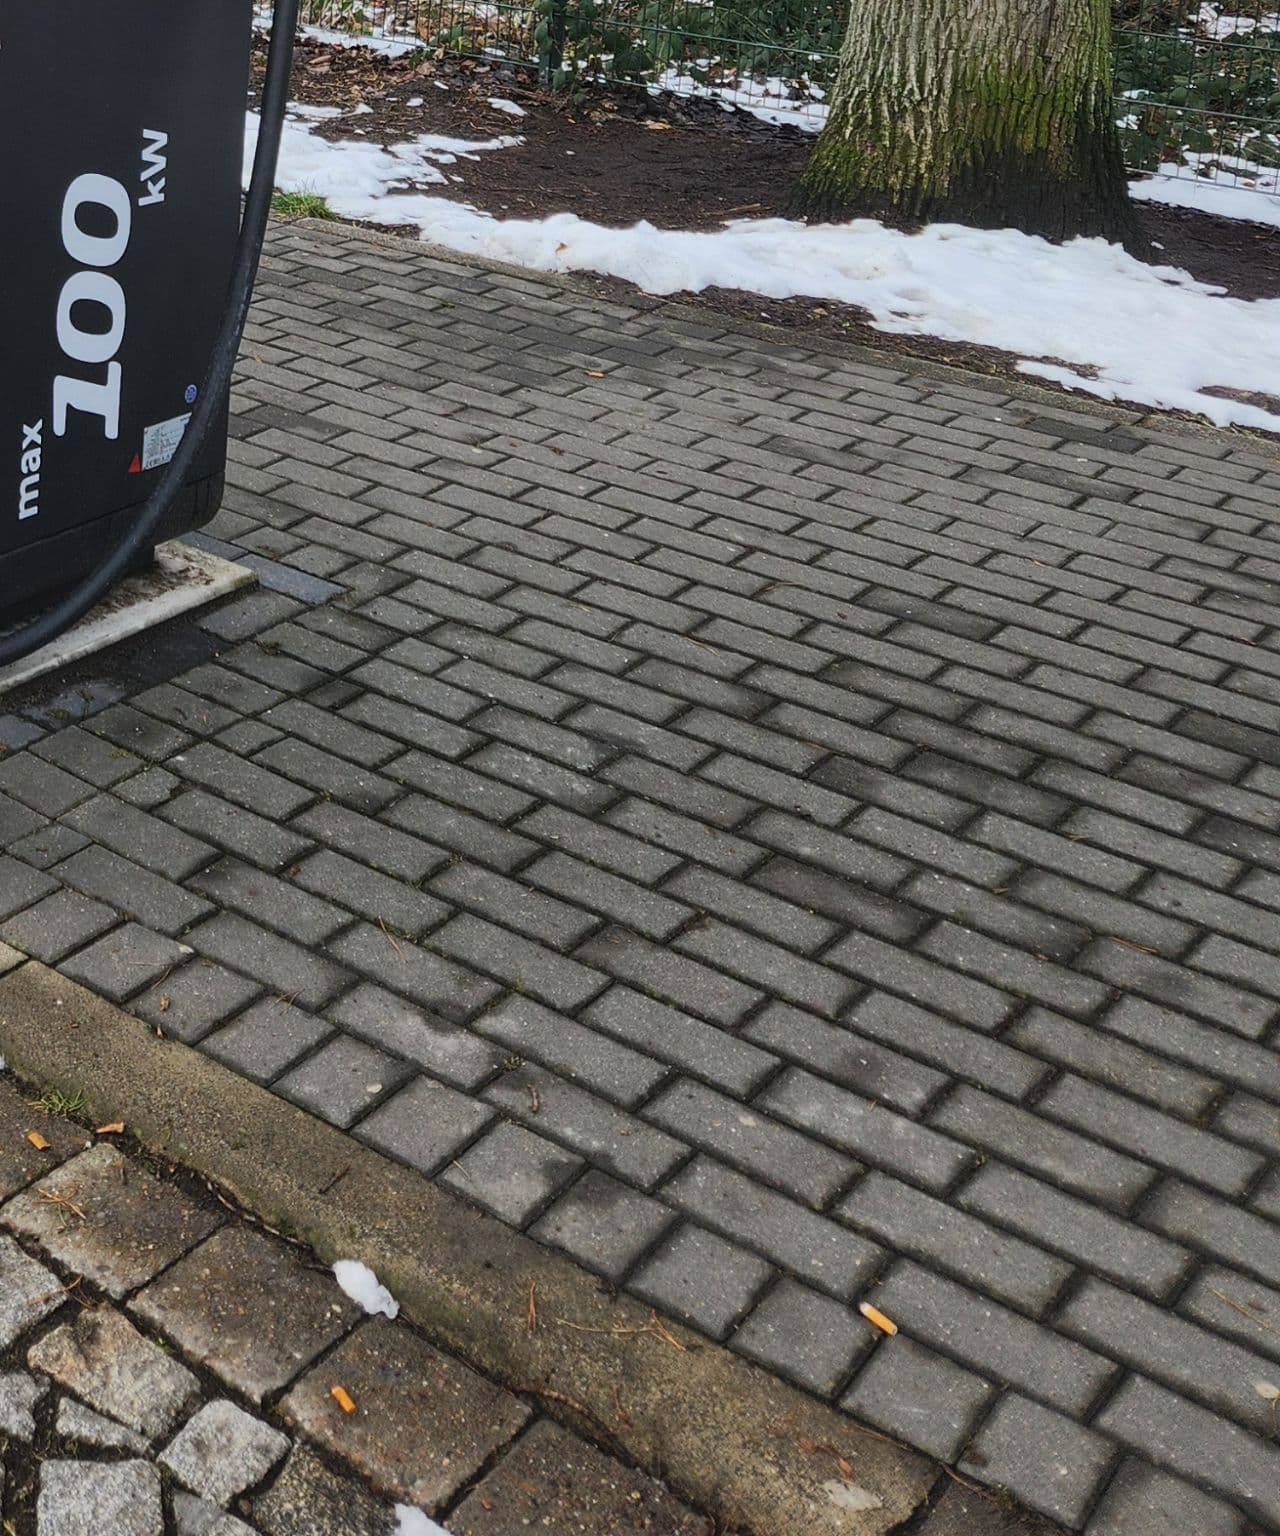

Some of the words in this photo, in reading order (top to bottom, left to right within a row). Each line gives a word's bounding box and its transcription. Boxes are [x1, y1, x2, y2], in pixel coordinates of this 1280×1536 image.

[18, 419, 44, 521] max
[51, 172, 132, 440] 100
[137, 128, 169, 208] kW
